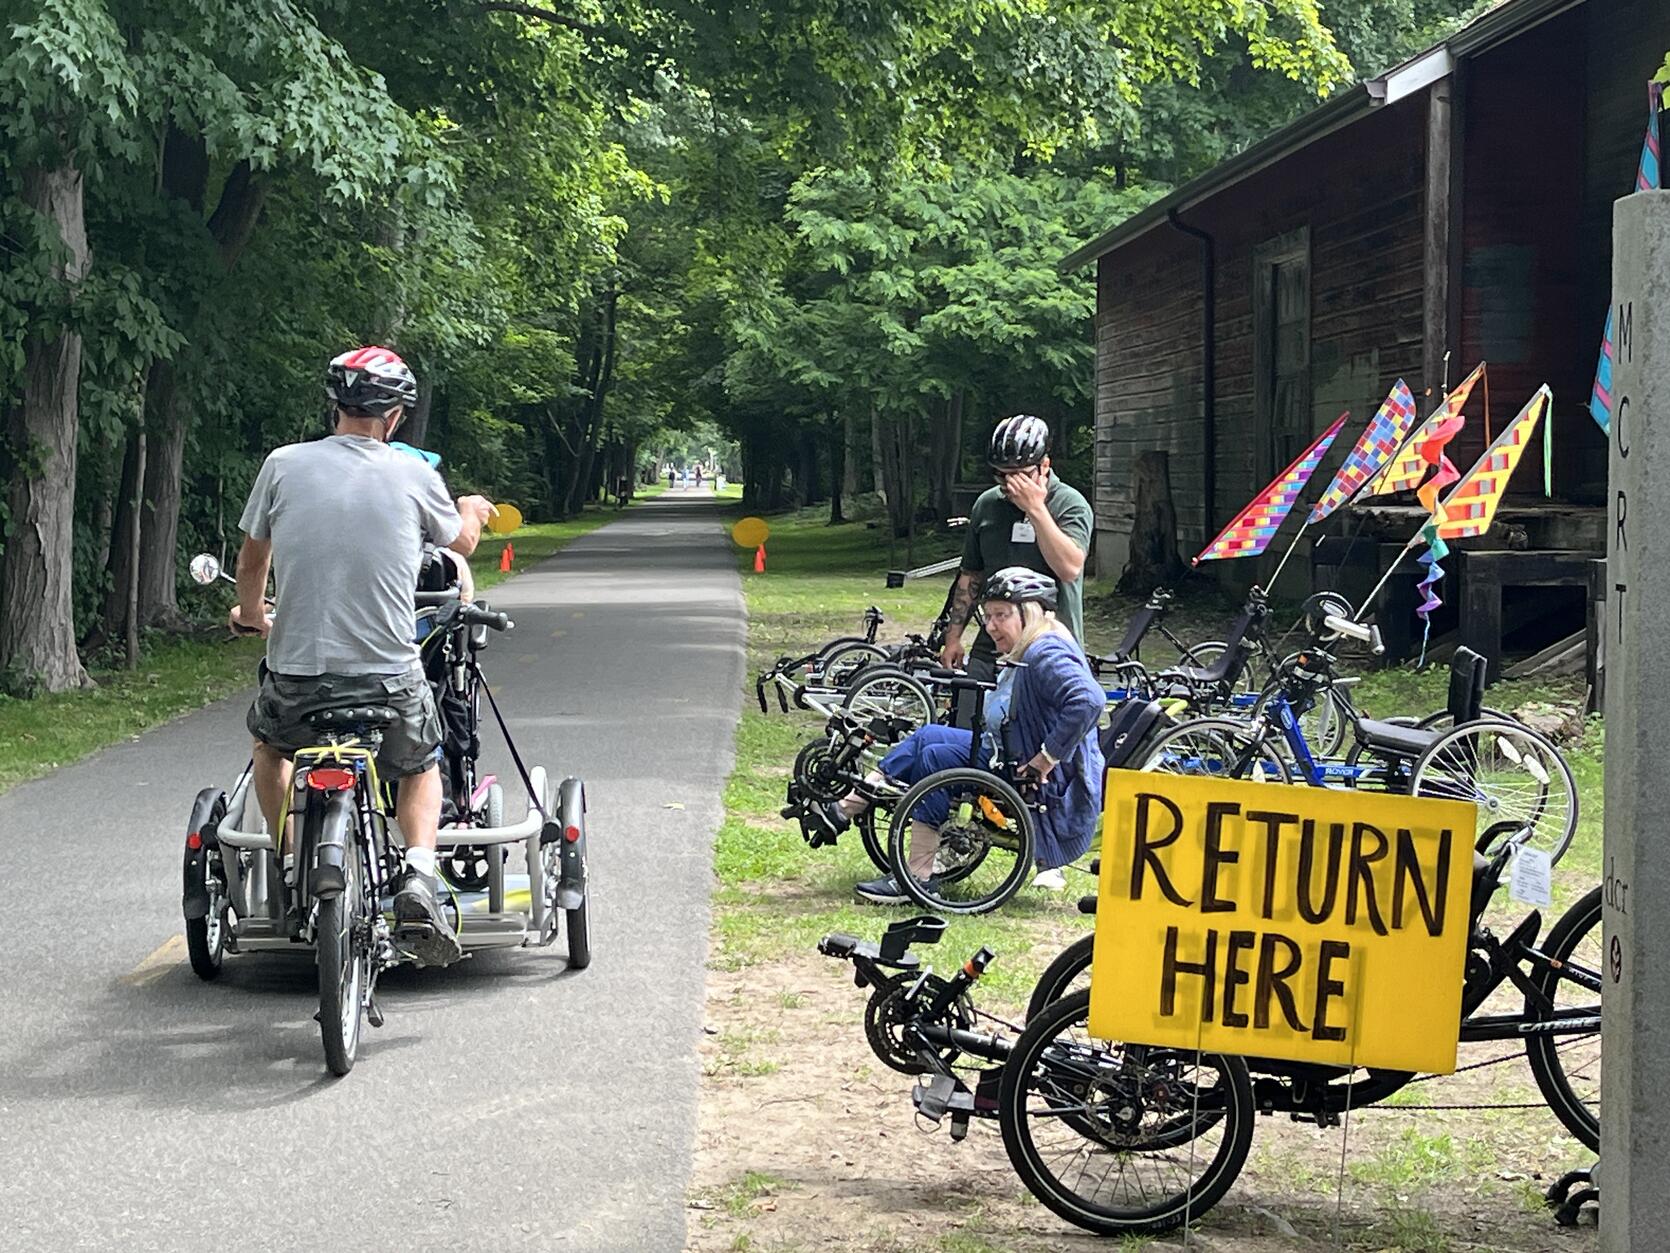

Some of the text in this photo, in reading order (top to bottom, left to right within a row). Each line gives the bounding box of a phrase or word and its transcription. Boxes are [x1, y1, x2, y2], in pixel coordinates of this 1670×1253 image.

[1129, 793, 1453, 937] RETURN
[1605, 856, 1629, 915] dcr
[1159, 926, 1351, 1042] HERE
